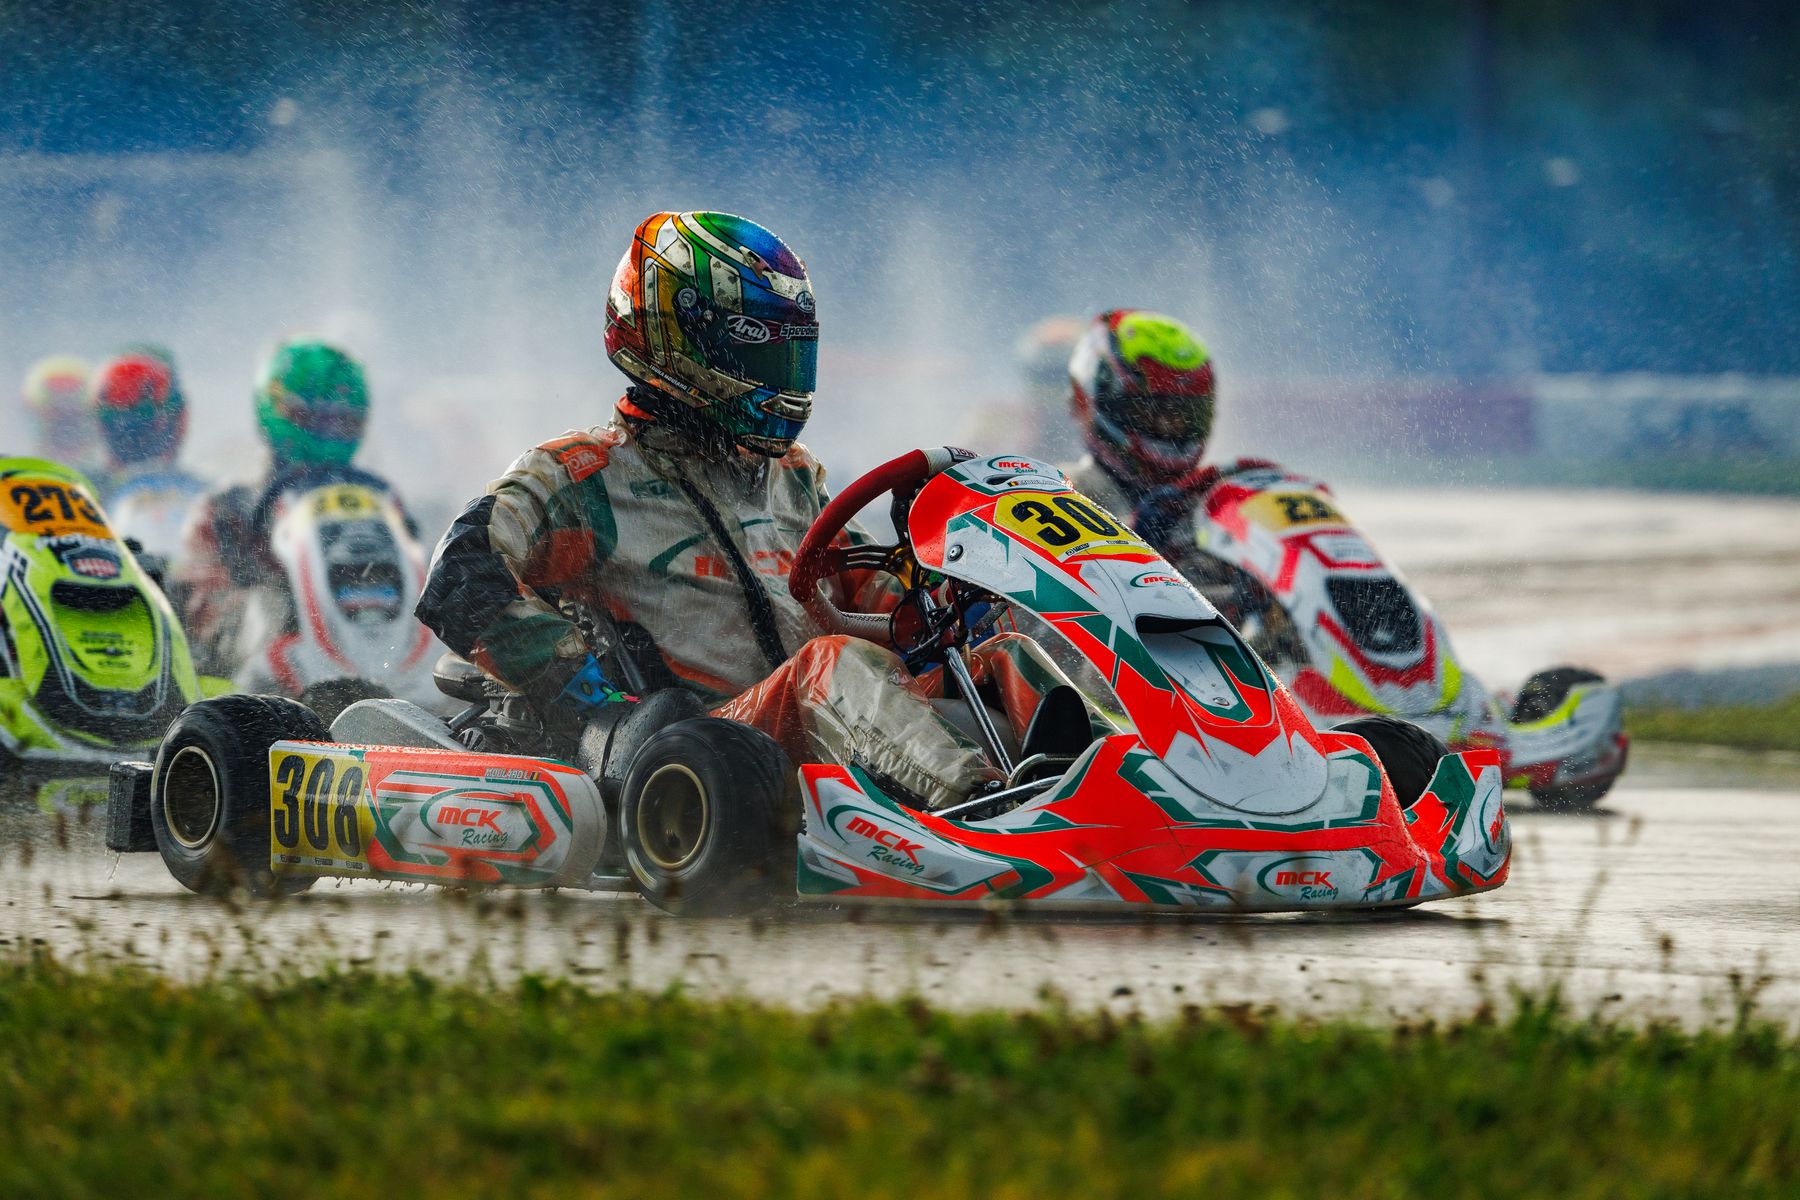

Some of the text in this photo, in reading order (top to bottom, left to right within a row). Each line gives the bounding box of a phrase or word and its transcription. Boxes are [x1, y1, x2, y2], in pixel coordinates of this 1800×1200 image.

[729, 318, 765, 339] Arai
[998, 461, 1034, 470] MCK
[274, 755, 363, 857] 308
[437, 806, 504, 834] MCK
[461, 828, 509, 849] Racing
[846, 816, 926, 867] MCK
[866, 845, 925, 875] Racing
[1275, 871, 1334, 890] MCK
[1300, 886, 1339, 900] Racing
